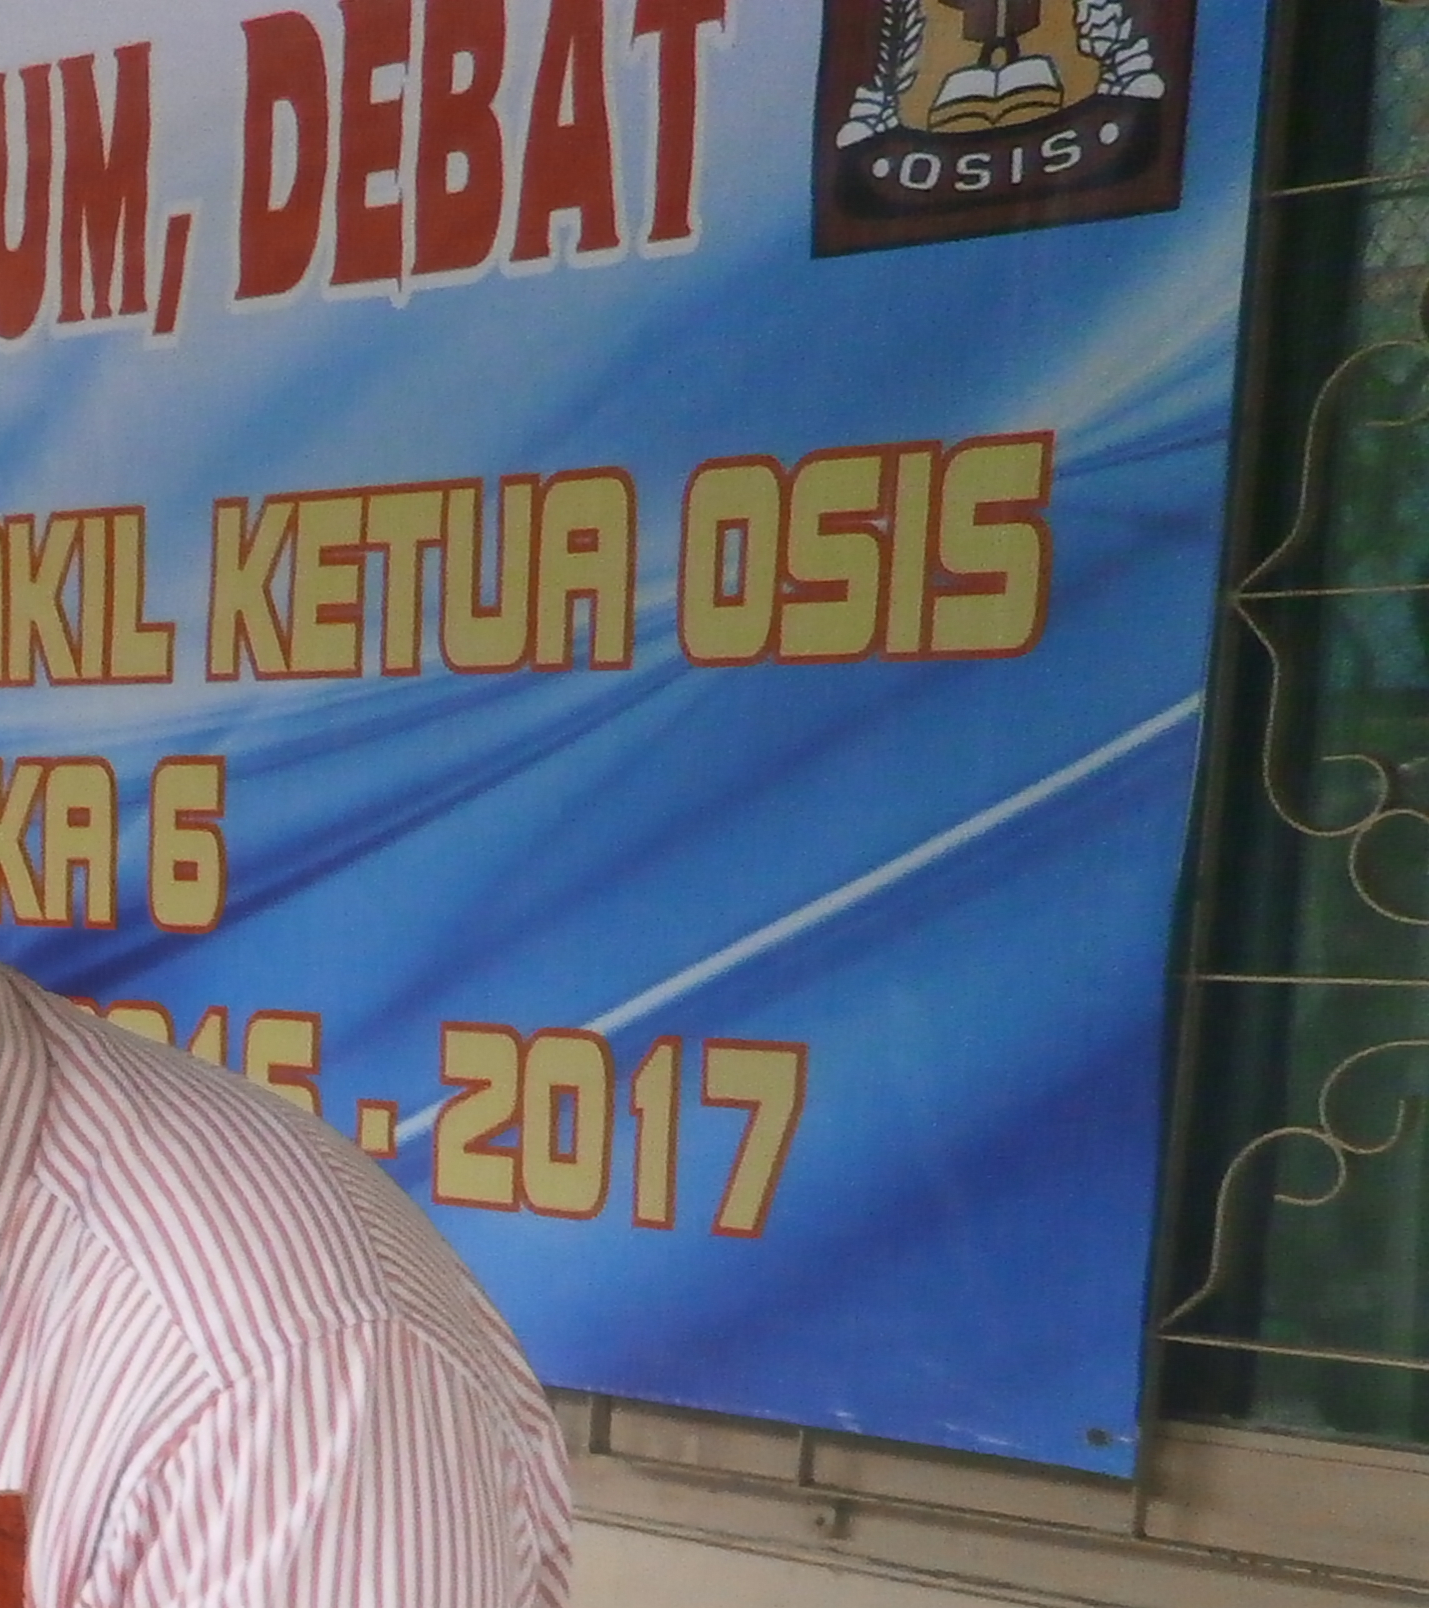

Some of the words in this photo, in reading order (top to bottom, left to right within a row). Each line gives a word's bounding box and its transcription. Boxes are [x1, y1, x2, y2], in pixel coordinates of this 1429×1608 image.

[233, 0, 728, 301] DEBAT
[899, 130, 1083, 191] OSIS
[205, 465, 638, 683] KETUA
[677, 429, 1056, 668] OSIS
[148, 755, 227, 935] 6
[432, 1020, 809, 1239] 2017
